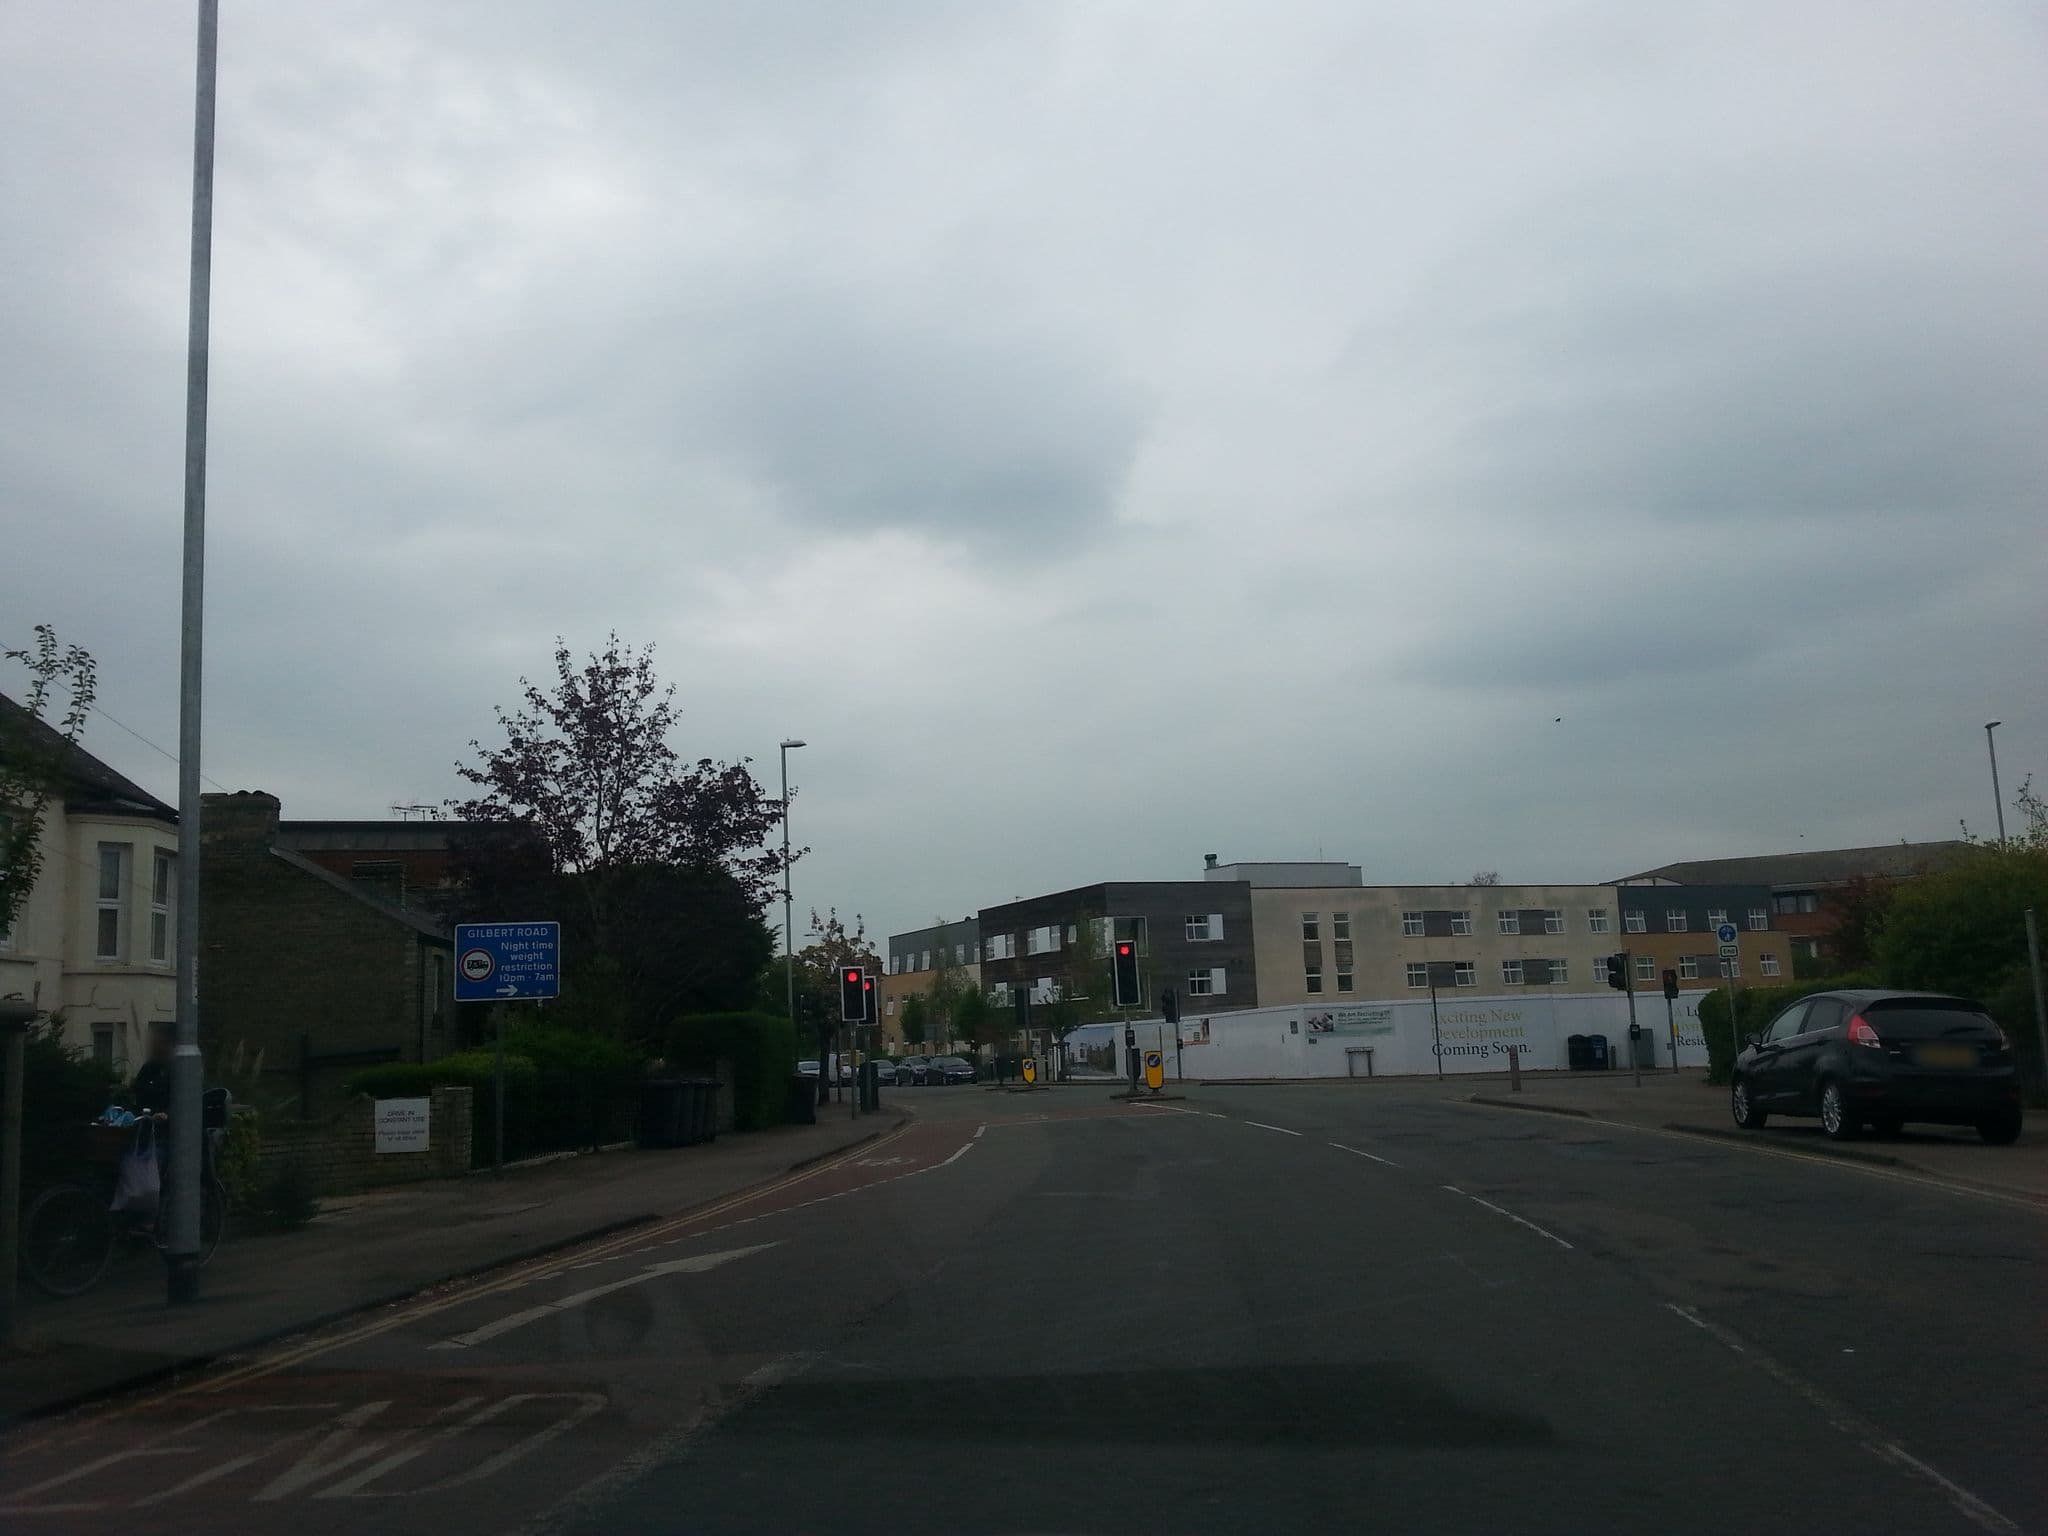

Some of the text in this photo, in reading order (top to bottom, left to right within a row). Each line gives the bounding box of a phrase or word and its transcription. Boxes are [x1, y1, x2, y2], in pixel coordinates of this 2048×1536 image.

[467, 927, 549, 939] GILBERT ROAD
[501, 940, 554, 952] Night time
[510, 951, 544, 962] weight
[501, 962, 553, 972] restriction
[499, 973, 526, 983] 10pm
[534, 972, 555, 981] 7am
[1490, 1008, 1522, 1022] New
[1431, 1024, 1525, 1041] Development
[1431, 1042, 1489, 1059] Coming
